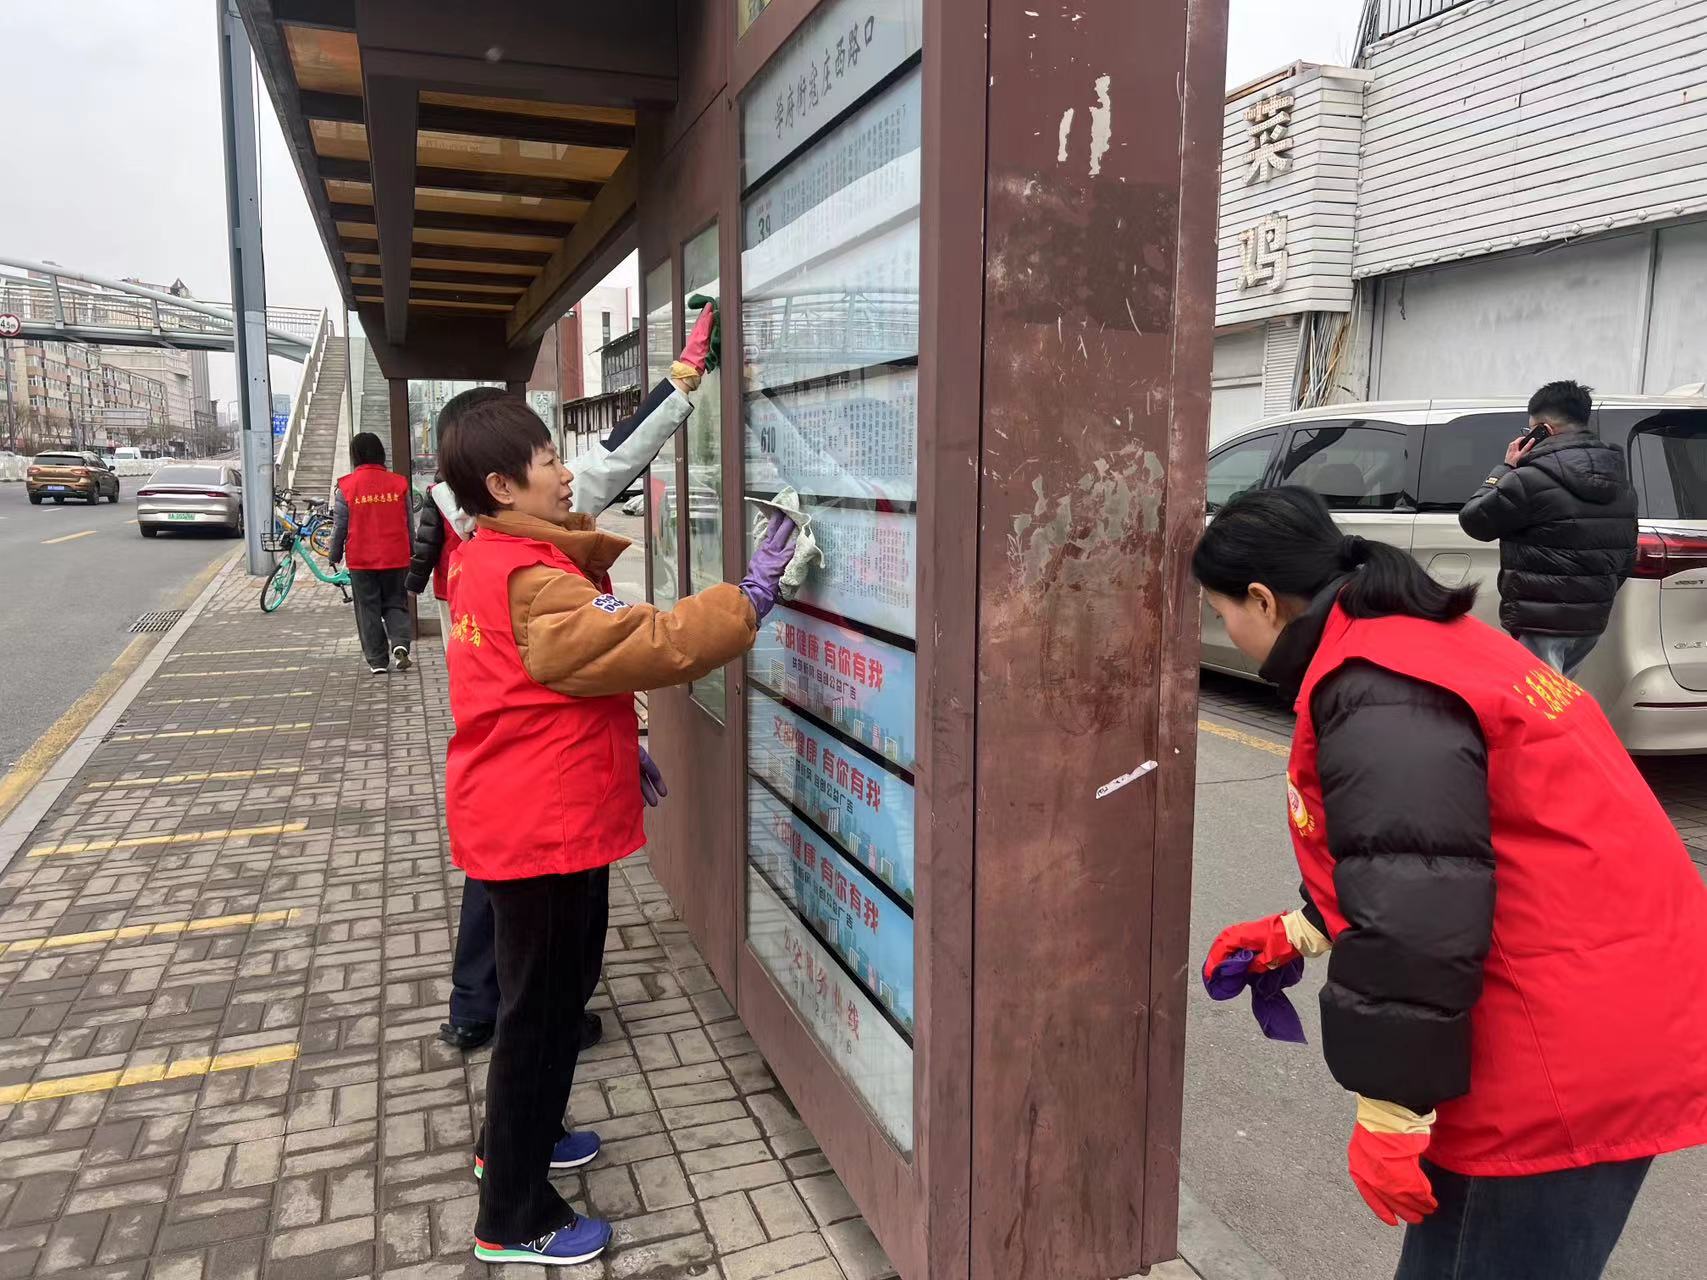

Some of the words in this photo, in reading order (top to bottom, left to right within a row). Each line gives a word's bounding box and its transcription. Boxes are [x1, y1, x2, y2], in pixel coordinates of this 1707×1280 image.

[760, 425, 776, 454] 610
[824, 640, 884, 692] 有你有我
[823, 748, 881, 813] 有你有我
[821, 857, 880, 935] 有你有我
